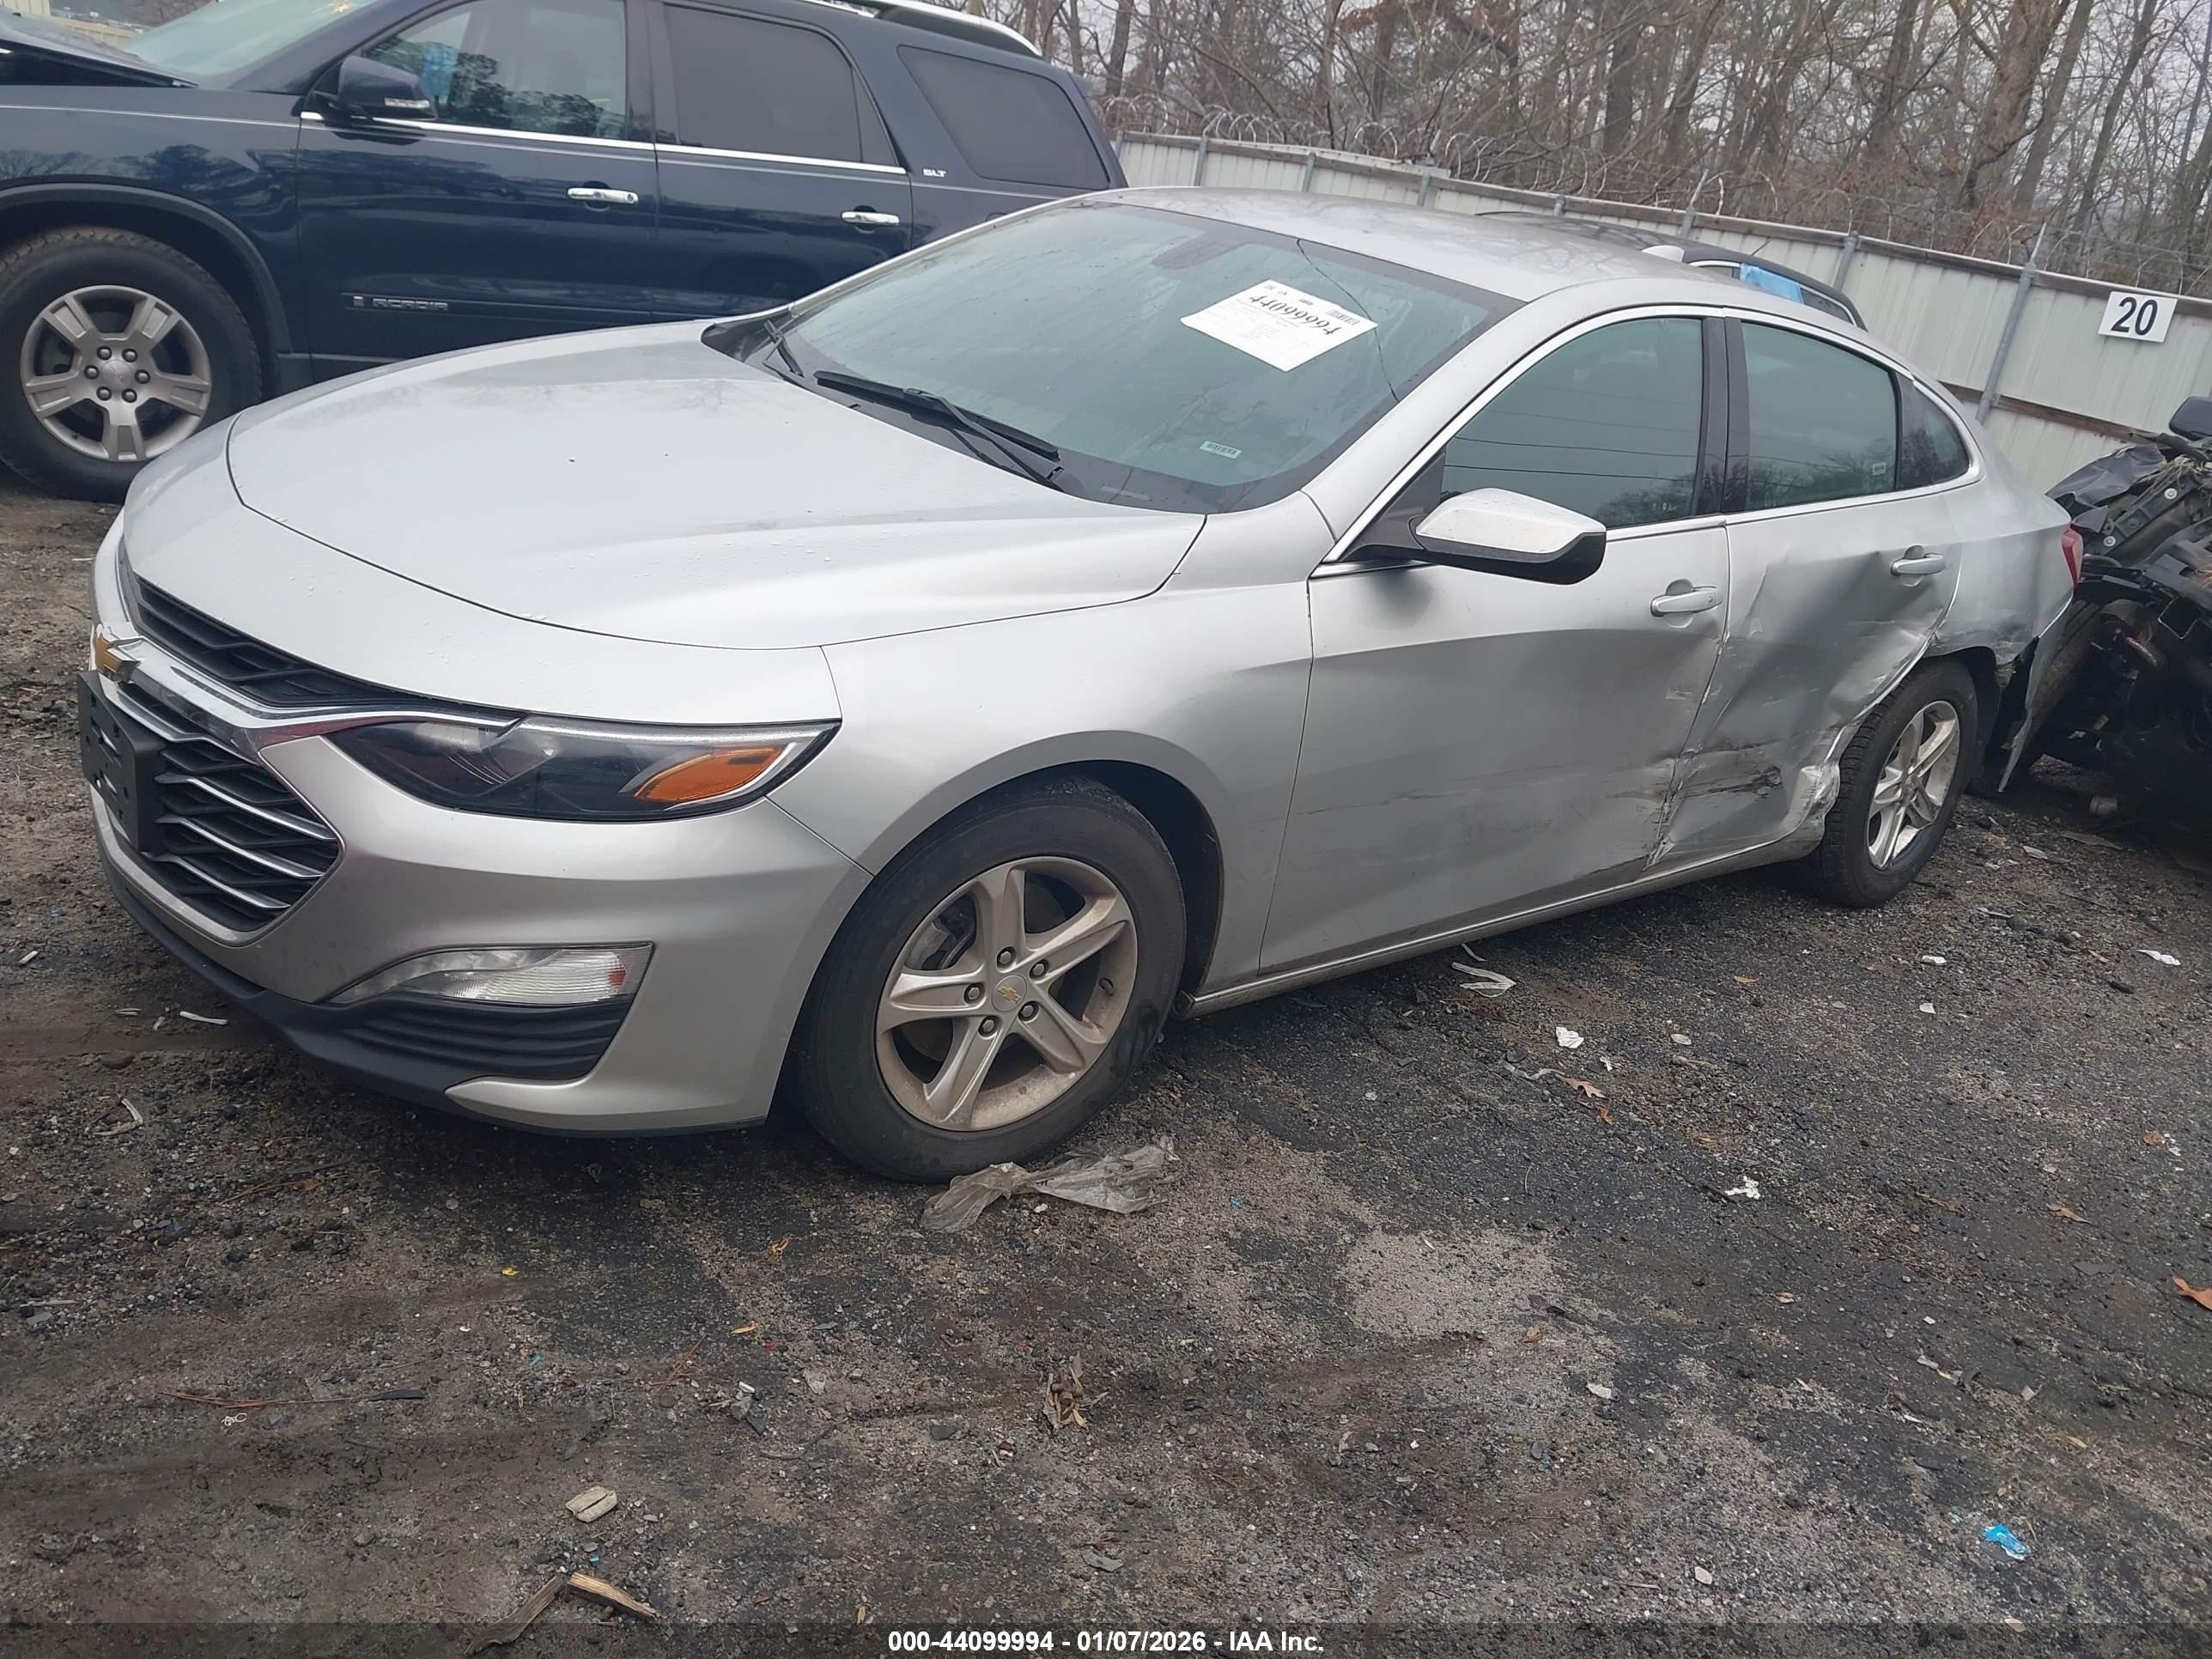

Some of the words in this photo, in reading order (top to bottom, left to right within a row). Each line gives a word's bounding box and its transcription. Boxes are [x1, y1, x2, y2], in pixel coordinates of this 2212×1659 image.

[923, 167, 947, 178] SLT
[372, 298, 448, 310] ACADIA
[1250, 295, 1342, 335] 44099994
[2110, 296, 2158, 336] 20
